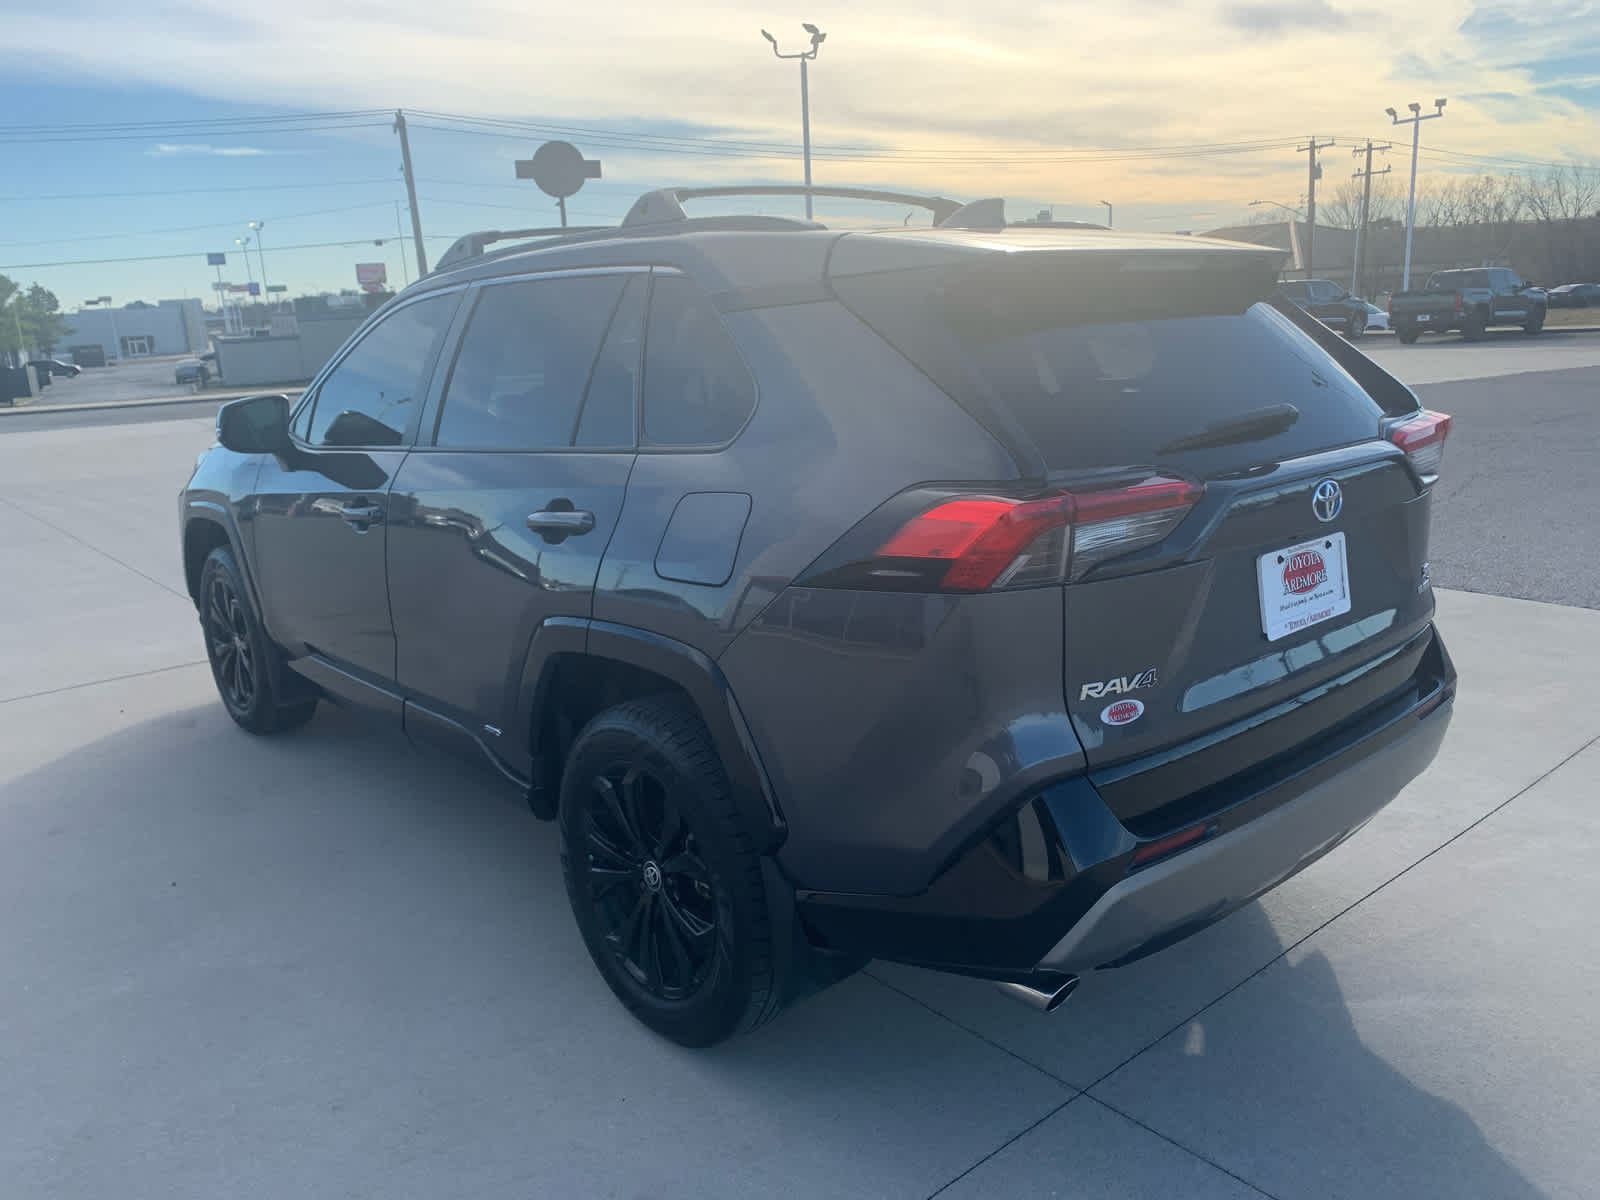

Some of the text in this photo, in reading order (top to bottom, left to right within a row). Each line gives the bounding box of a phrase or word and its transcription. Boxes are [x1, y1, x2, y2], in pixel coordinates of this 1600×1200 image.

[1286, 551, 1321, 572] TOYOTA
[1283, 569, 1328, 594] ARDMORE
[1080, 667, 1157, 701] RAV4
